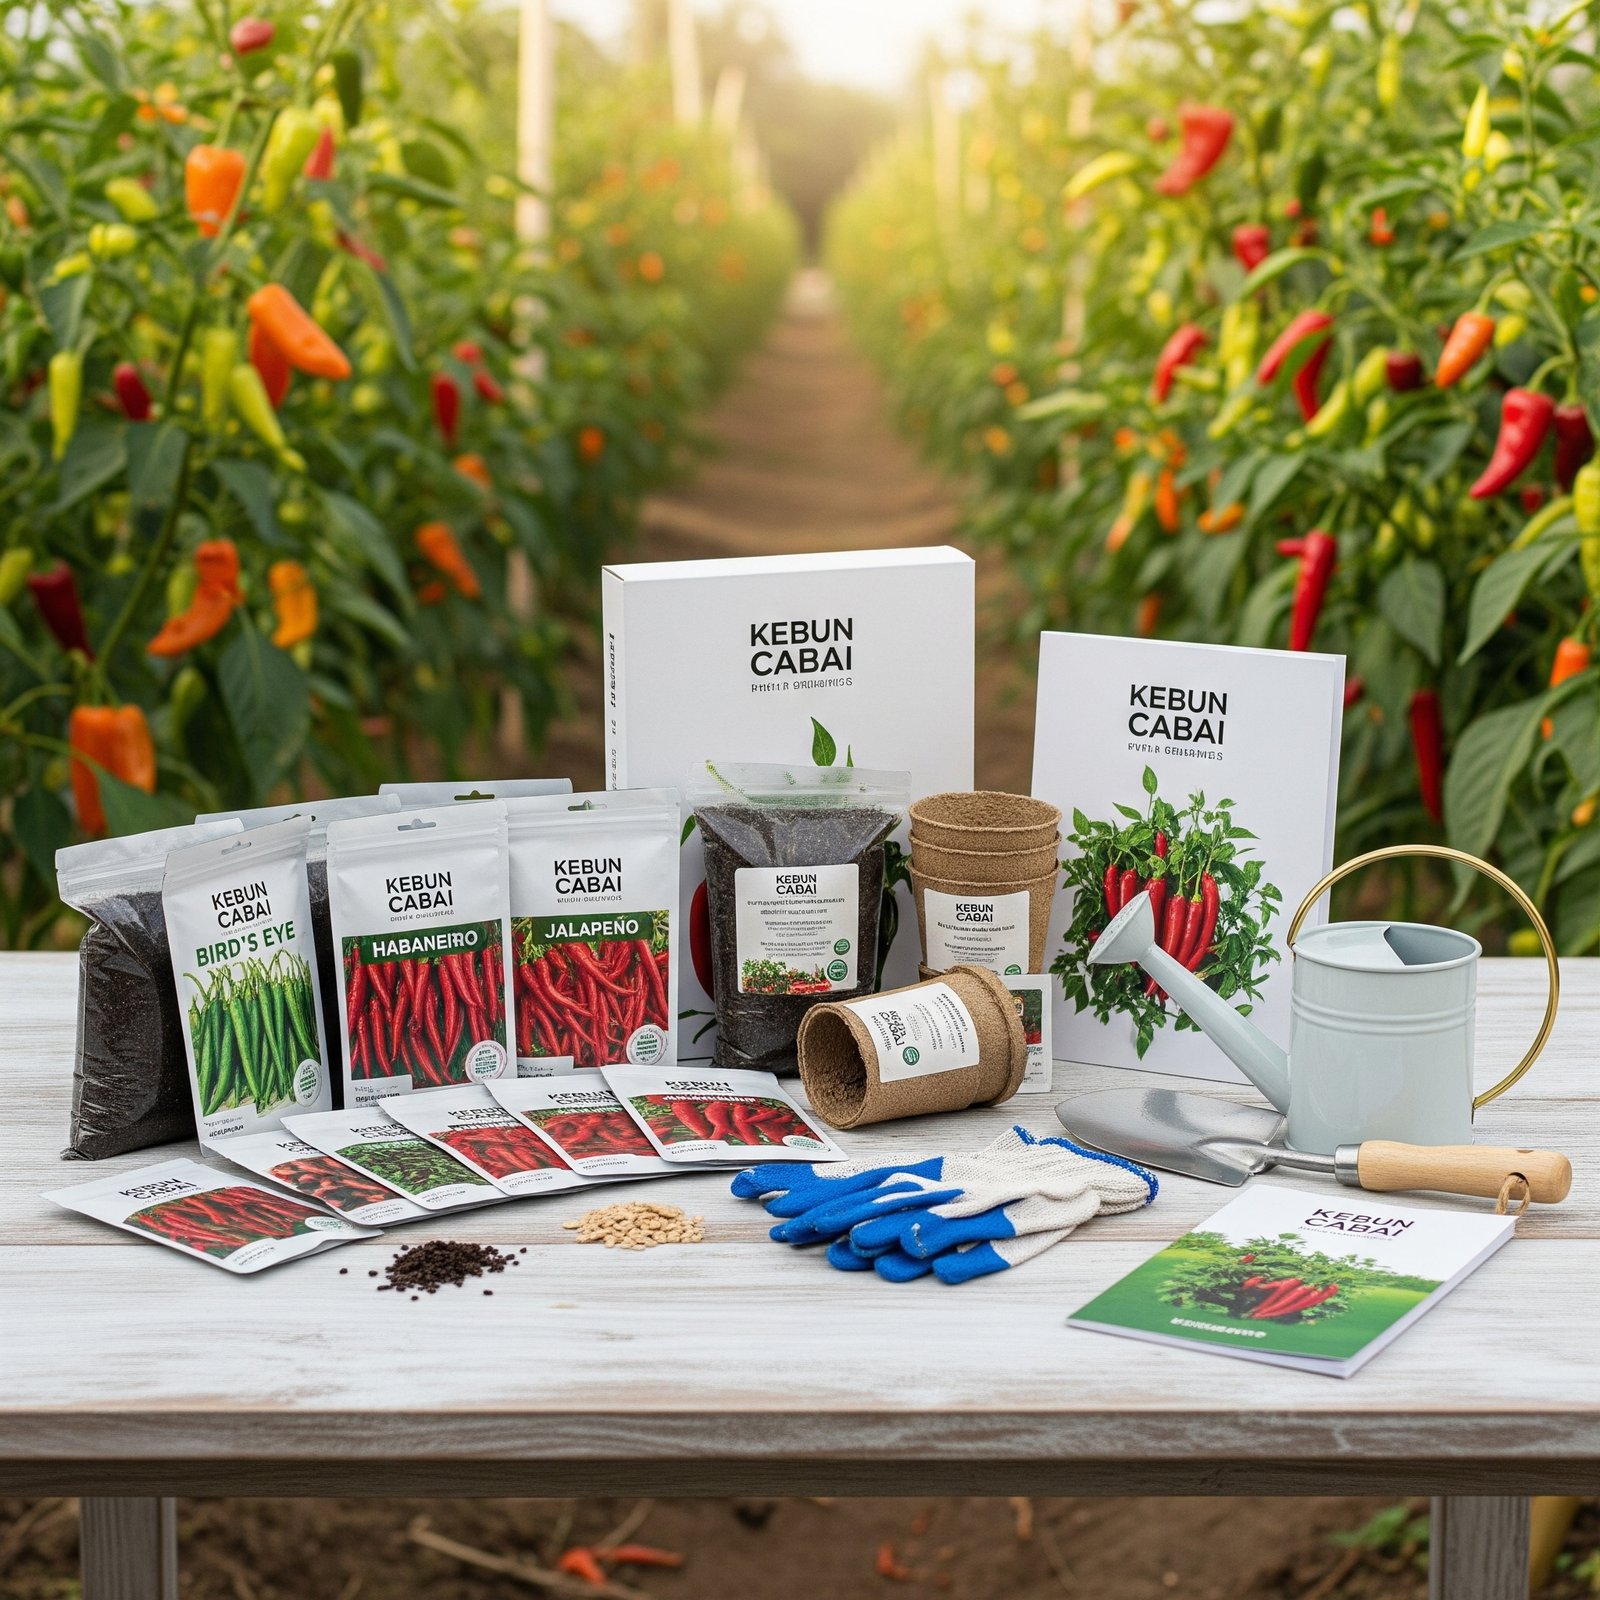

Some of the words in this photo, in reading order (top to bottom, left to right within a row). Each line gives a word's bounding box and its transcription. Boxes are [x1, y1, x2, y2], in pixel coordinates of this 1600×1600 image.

[750, 617, 853, 647] KEBUN
[750, 645, 852, 676] CABAI
[1130, 684, 1227, 715] KEBUN
[1128, 712, 1225, 745] CABAI
[553, 857, 622, 876] KEBUN
[211, 880, 268, 911] KEBUN
[385, 871, 452, 894] KEBUN
[555, 876, 622, 895] CABAI
[217, 898, 272, 929] CABAI
[388, 889, 454, 913] CABAI
[955, 903, 994, 913] KEBUN
[195, 933, 258, 968] BIRD'S
[262, 920, 296, 947] EYE
[1304, 1217, 1403, 1237] CABAI
[1312, 1208, 1415, 1229] KEBUN
